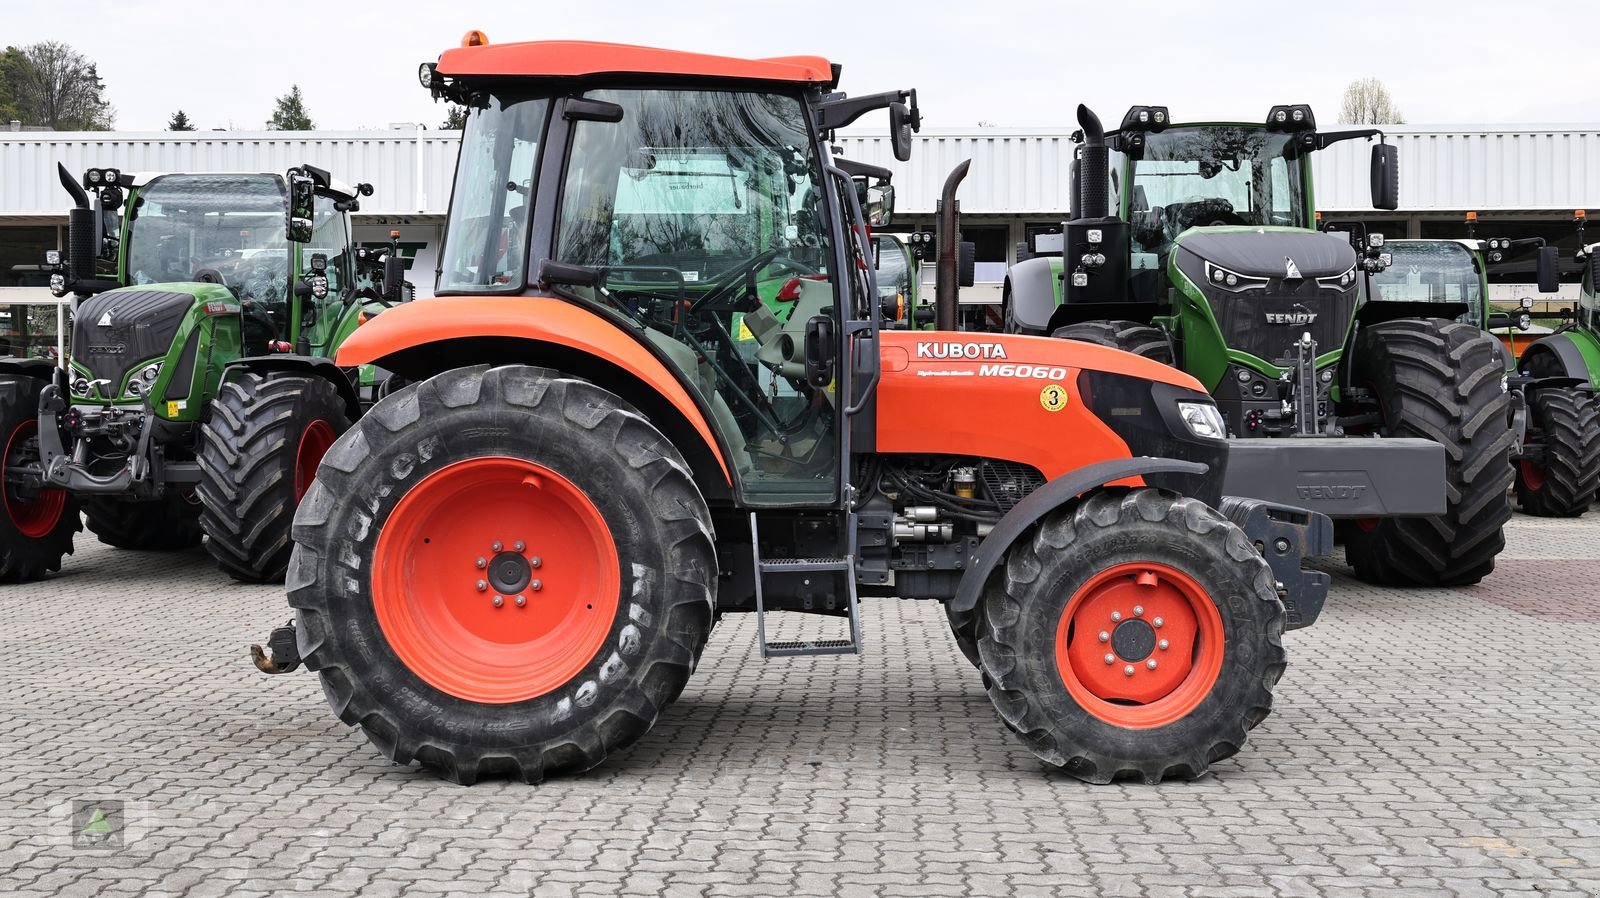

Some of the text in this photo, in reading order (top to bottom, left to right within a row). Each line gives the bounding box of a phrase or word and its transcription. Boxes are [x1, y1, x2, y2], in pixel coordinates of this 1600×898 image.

[1266, 313, 1318, 324] FENDT
[916, 342, 1008, 360] KUBOTA
[978, 364, 1066, 380] M6060
[1048, 390, 1058, 406] 3
[1296, 485, 1367, 500] FENDT
